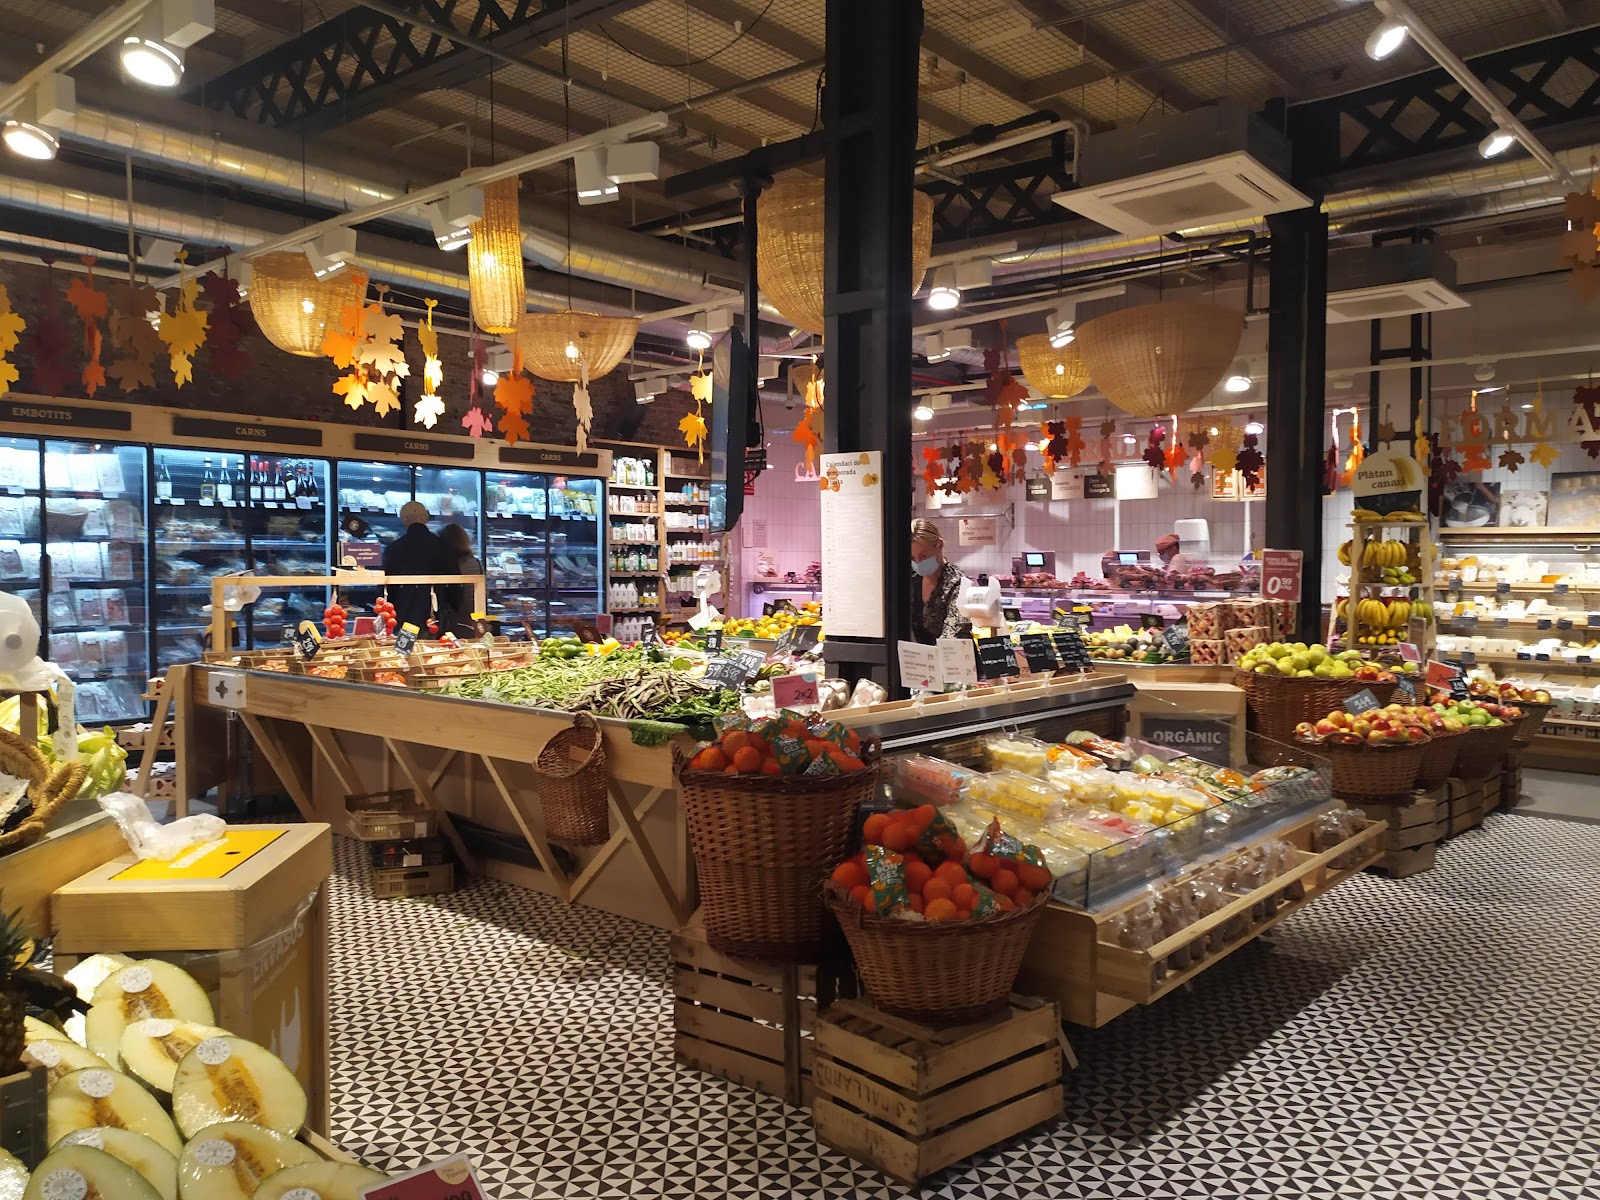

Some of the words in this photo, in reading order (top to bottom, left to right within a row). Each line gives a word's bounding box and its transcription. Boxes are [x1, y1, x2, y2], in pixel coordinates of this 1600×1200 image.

[12, 407, 73, 420] EMBOTITS
[235, 426, 267, 438] CARNS
[404, 441, 430, 452] CARNS
[540, 452, 562, 463] CARNS
[1267, 576, 1281, 594] 0
[1153, 728, 1222, 744] ORGÀNIC
[43, 1170, 82, 1194] AMETLLER
